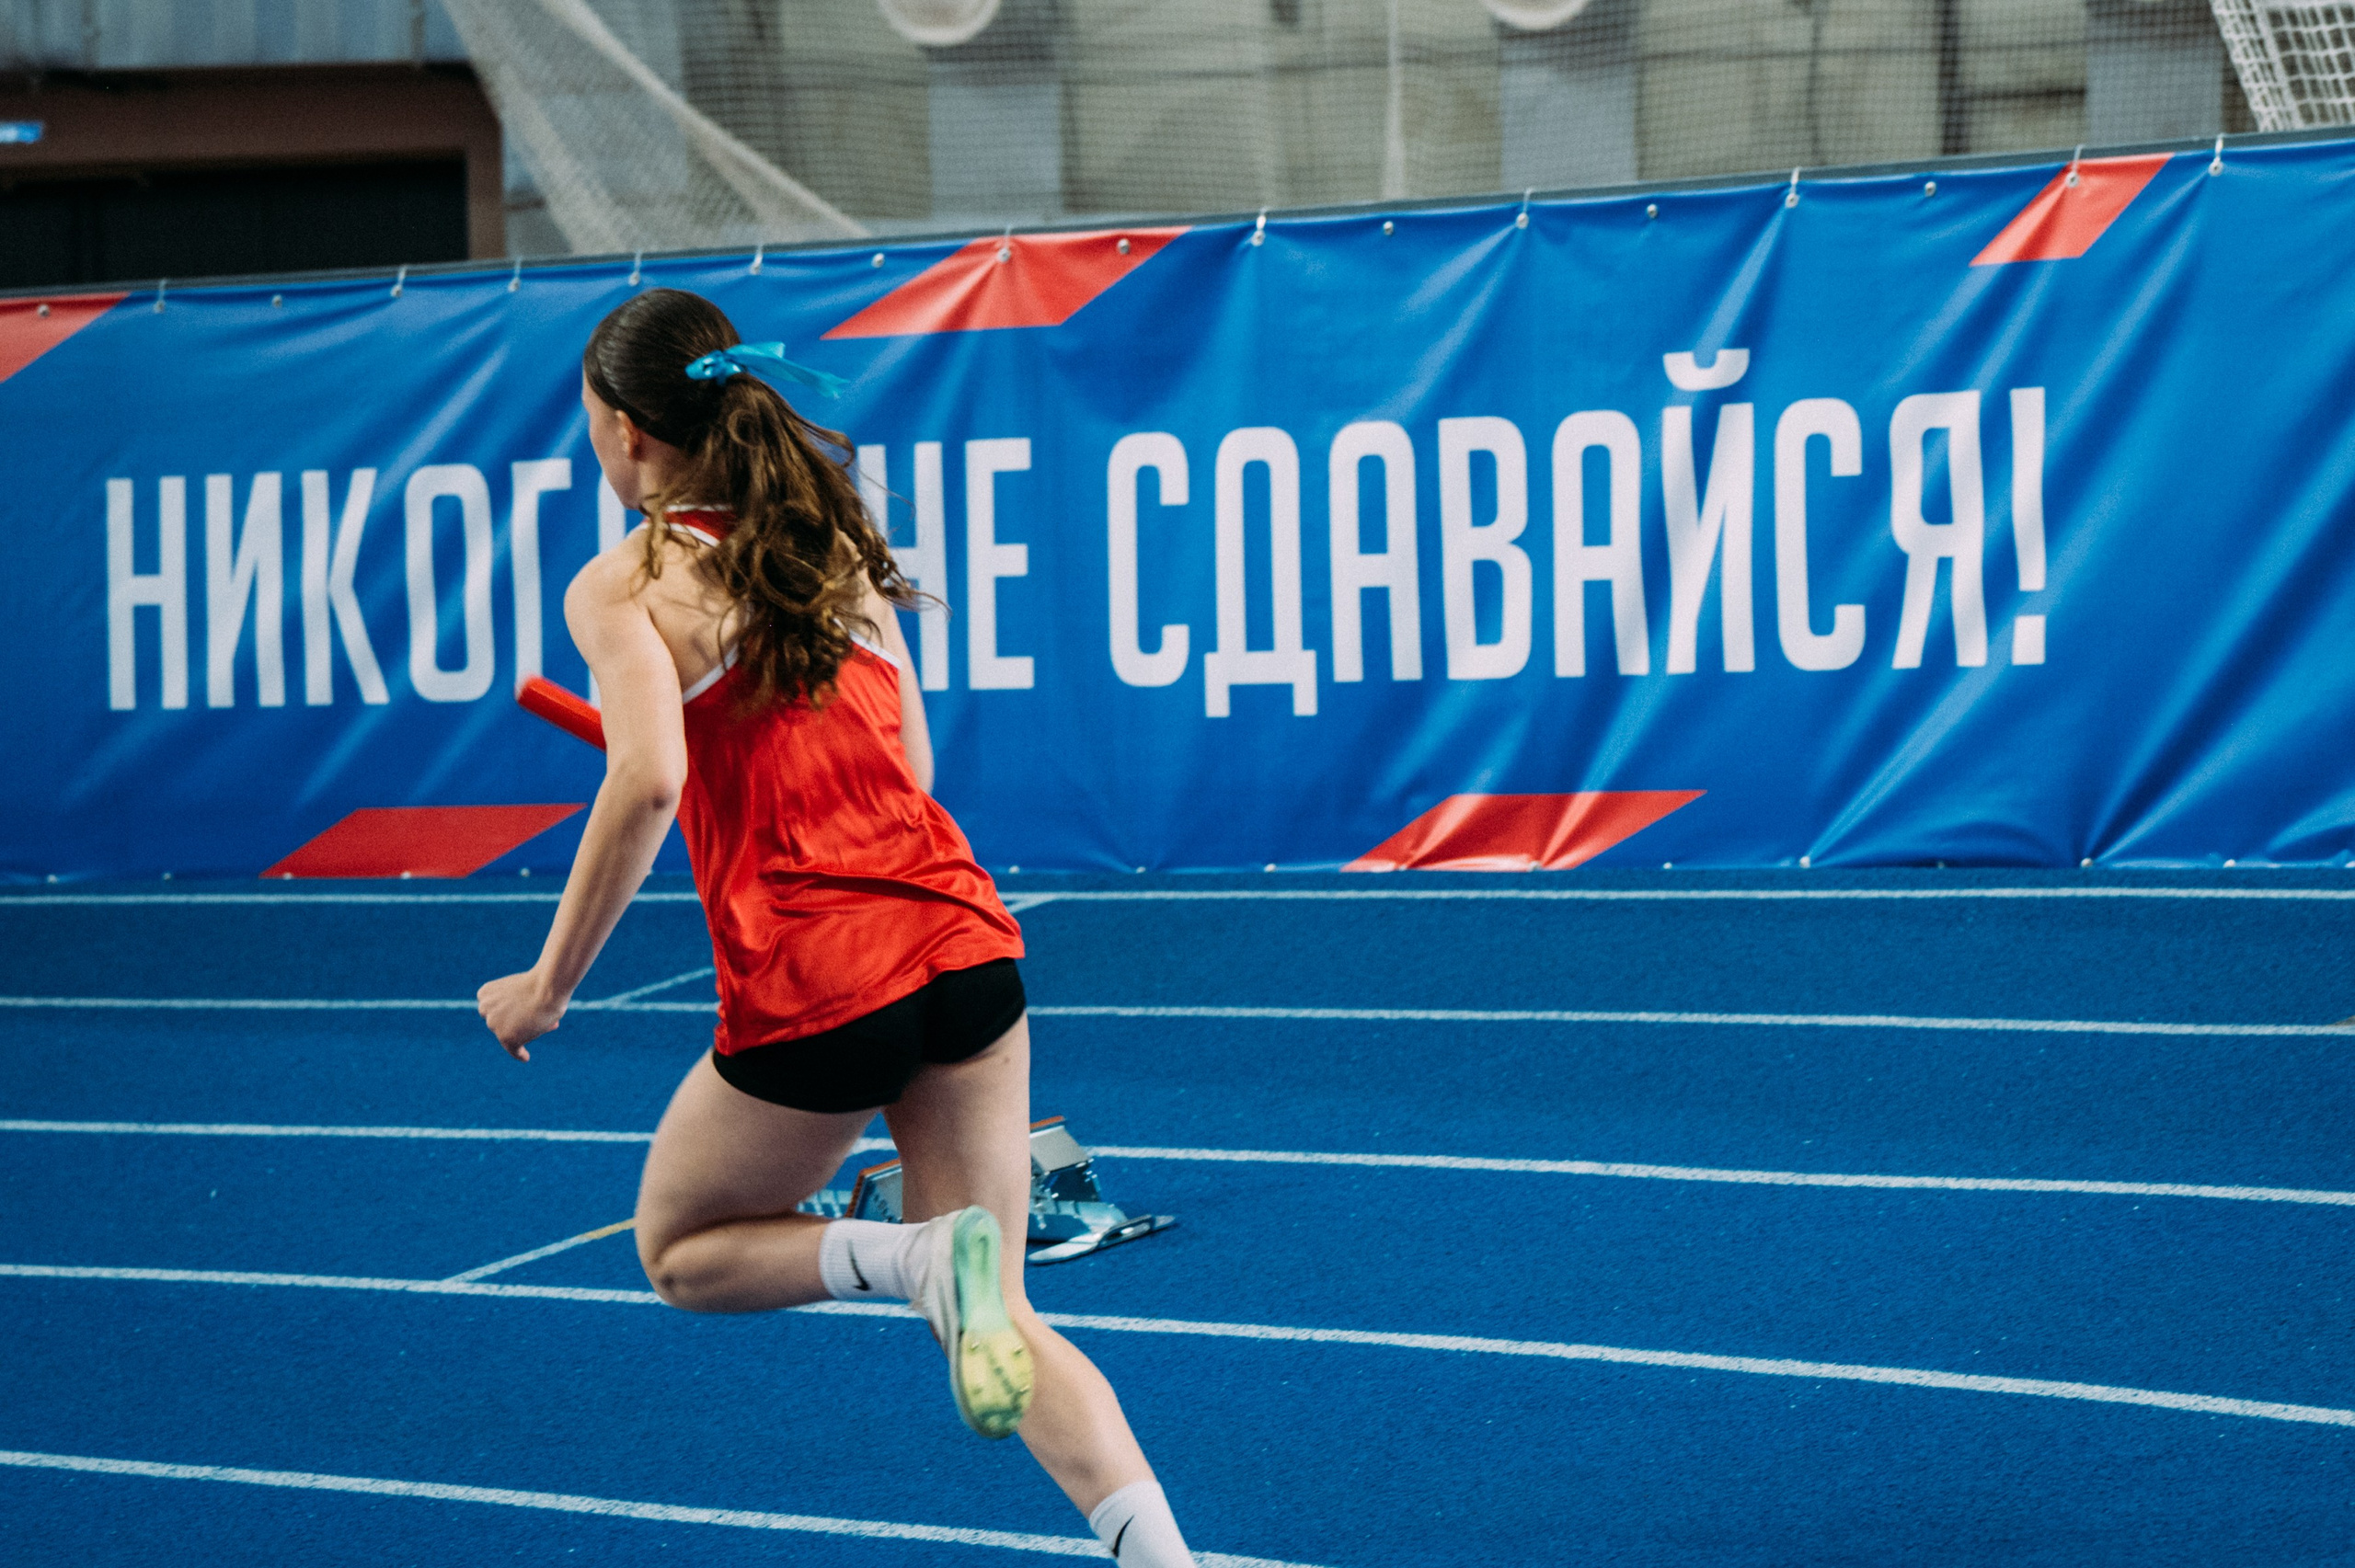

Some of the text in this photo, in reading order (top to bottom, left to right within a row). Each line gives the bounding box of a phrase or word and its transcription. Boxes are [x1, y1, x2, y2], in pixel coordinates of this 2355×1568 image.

[105, 348, 2048, 719] НИКОГ НЕ СДАВАЙСЯ!
